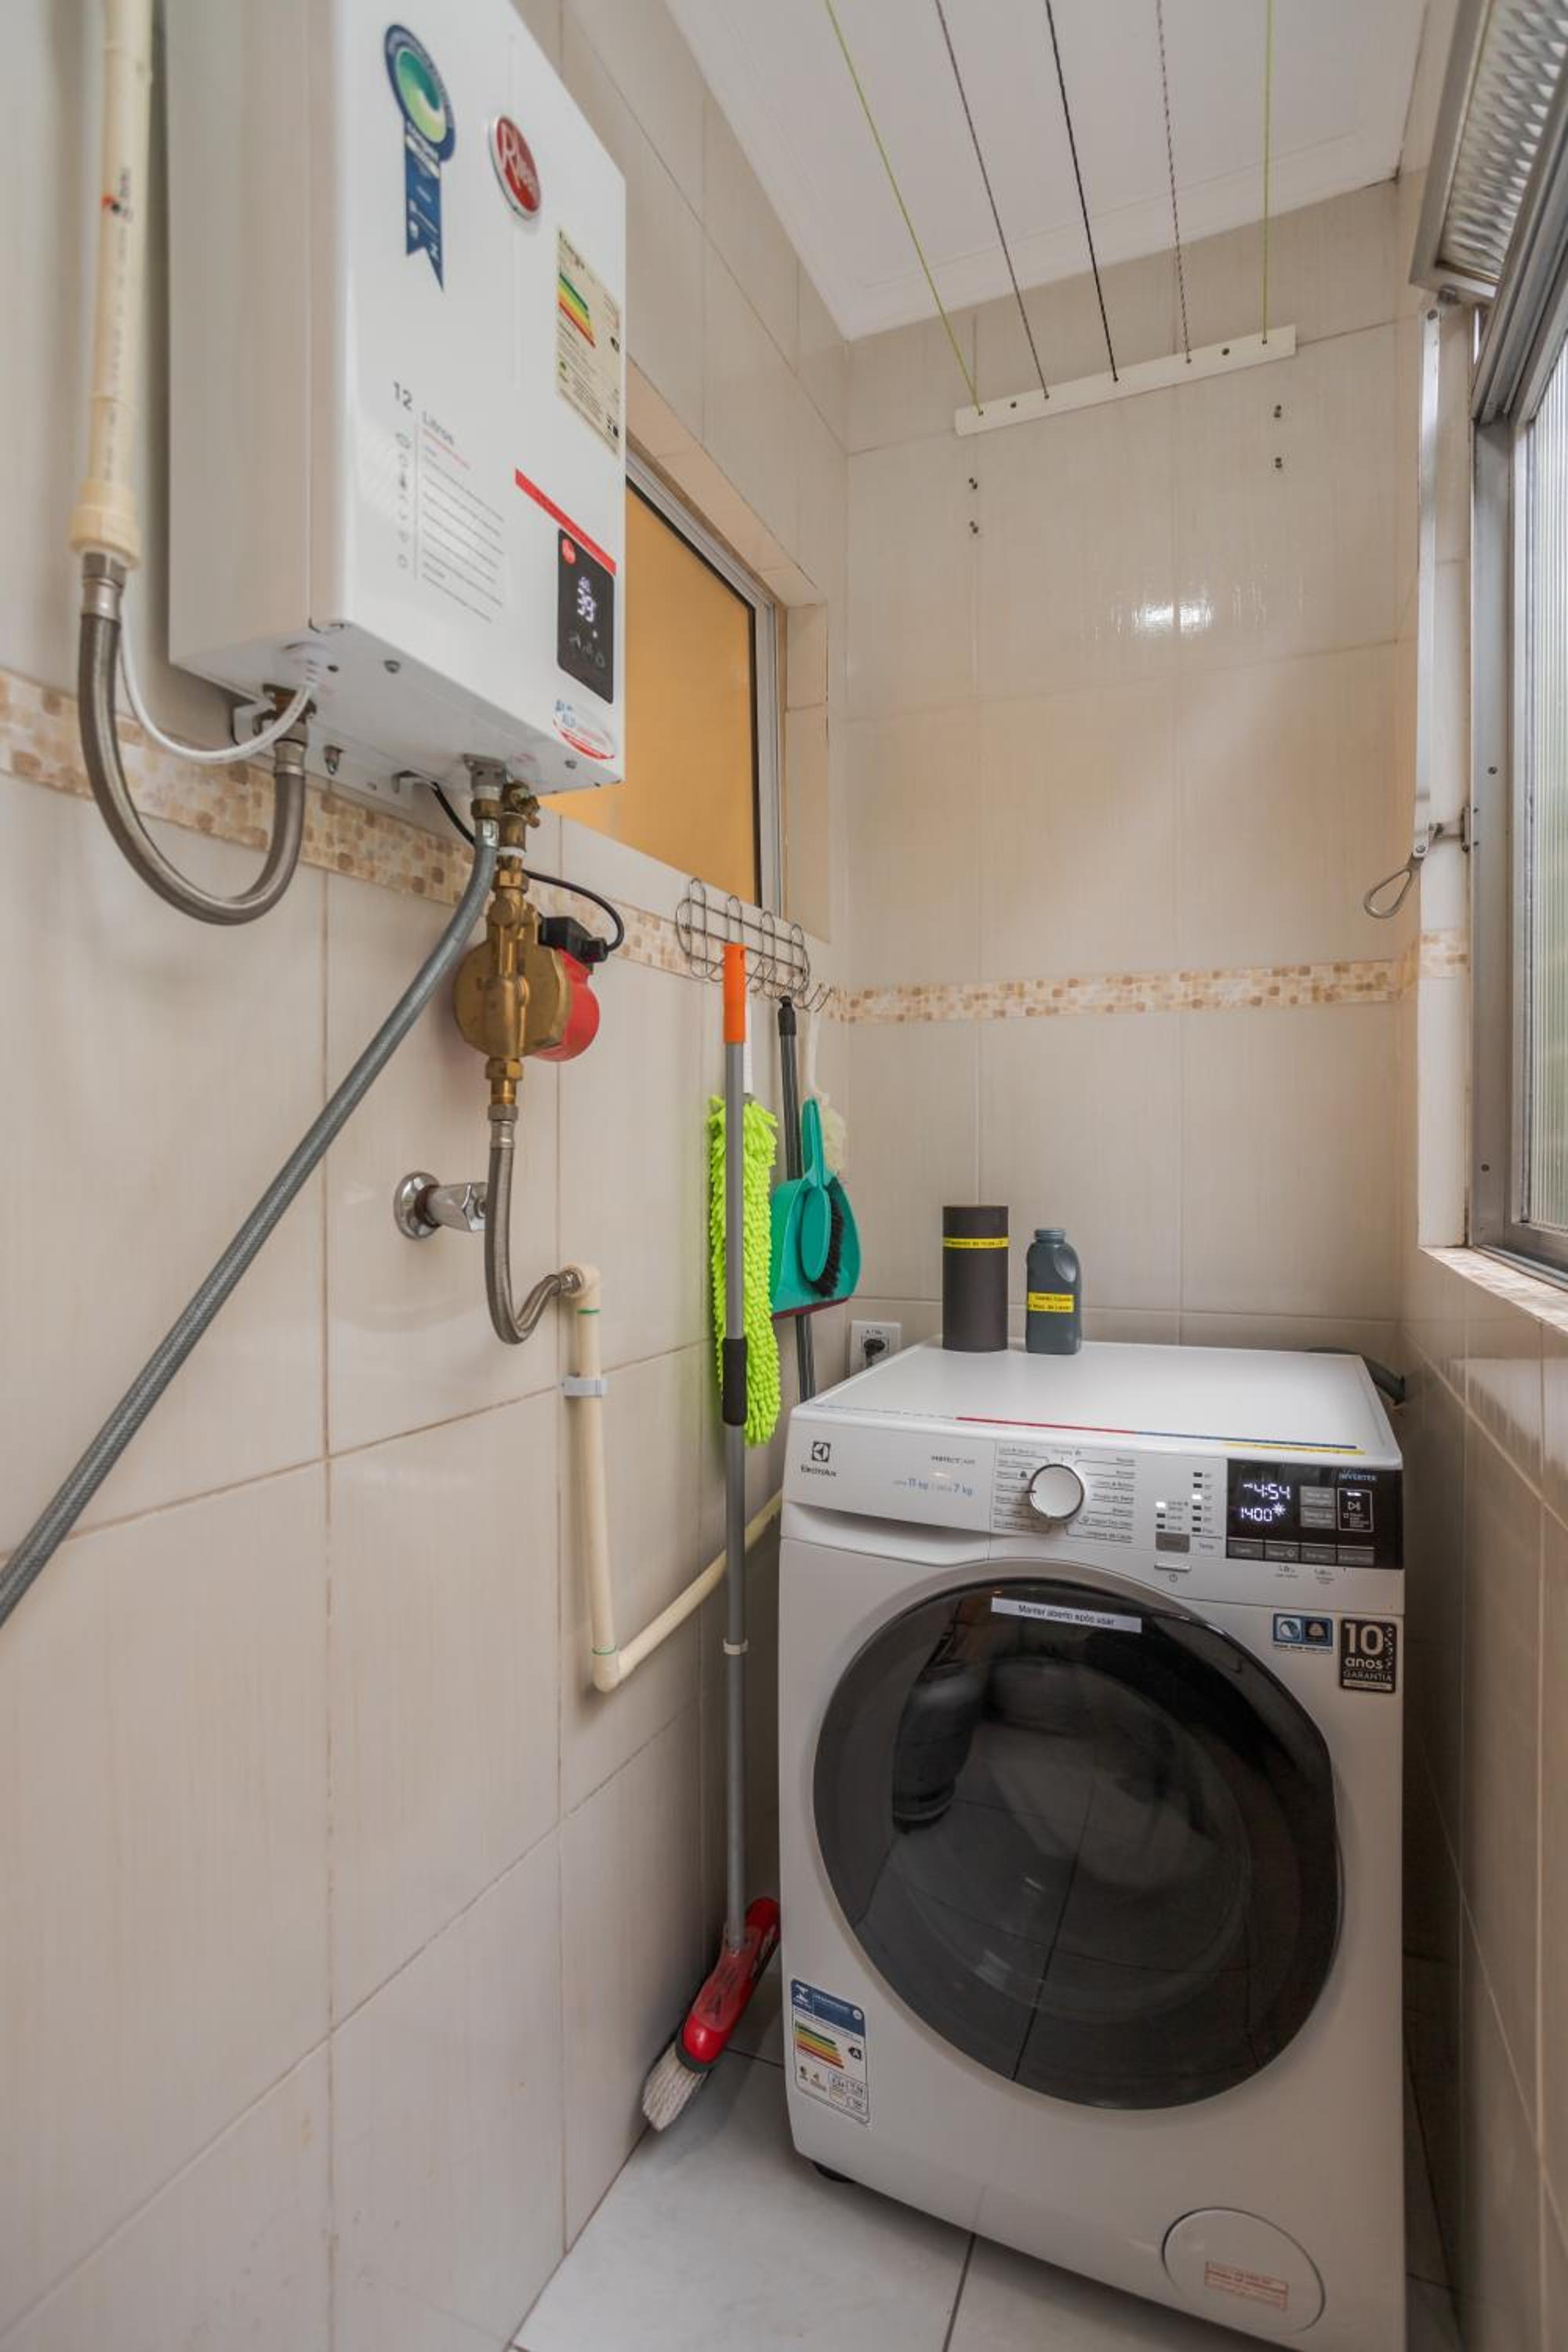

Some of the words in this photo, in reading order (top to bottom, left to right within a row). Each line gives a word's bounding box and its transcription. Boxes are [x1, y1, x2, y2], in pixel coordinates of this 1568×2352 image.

[394, 381, 412, 410] 12
[800, 1465, 837, 1478] Electrolux
[1338, 1472, 1377, 1482] INVERTER
[1254, 1483, 1290, 1500] 4:54
[1240, 1507, 1272, 1522] 1400
[1018, 1604, 1046, 1617] Manter
[1047, 1610, 1073, 1621] aberto
[1097, 1617, 1115, 1626] usar
[1345, 1622, 1384, 1656] 10
[1345, 1657, 1384, 1670] anos
[1343, 1670, 1393, 1682] GARANTIA
